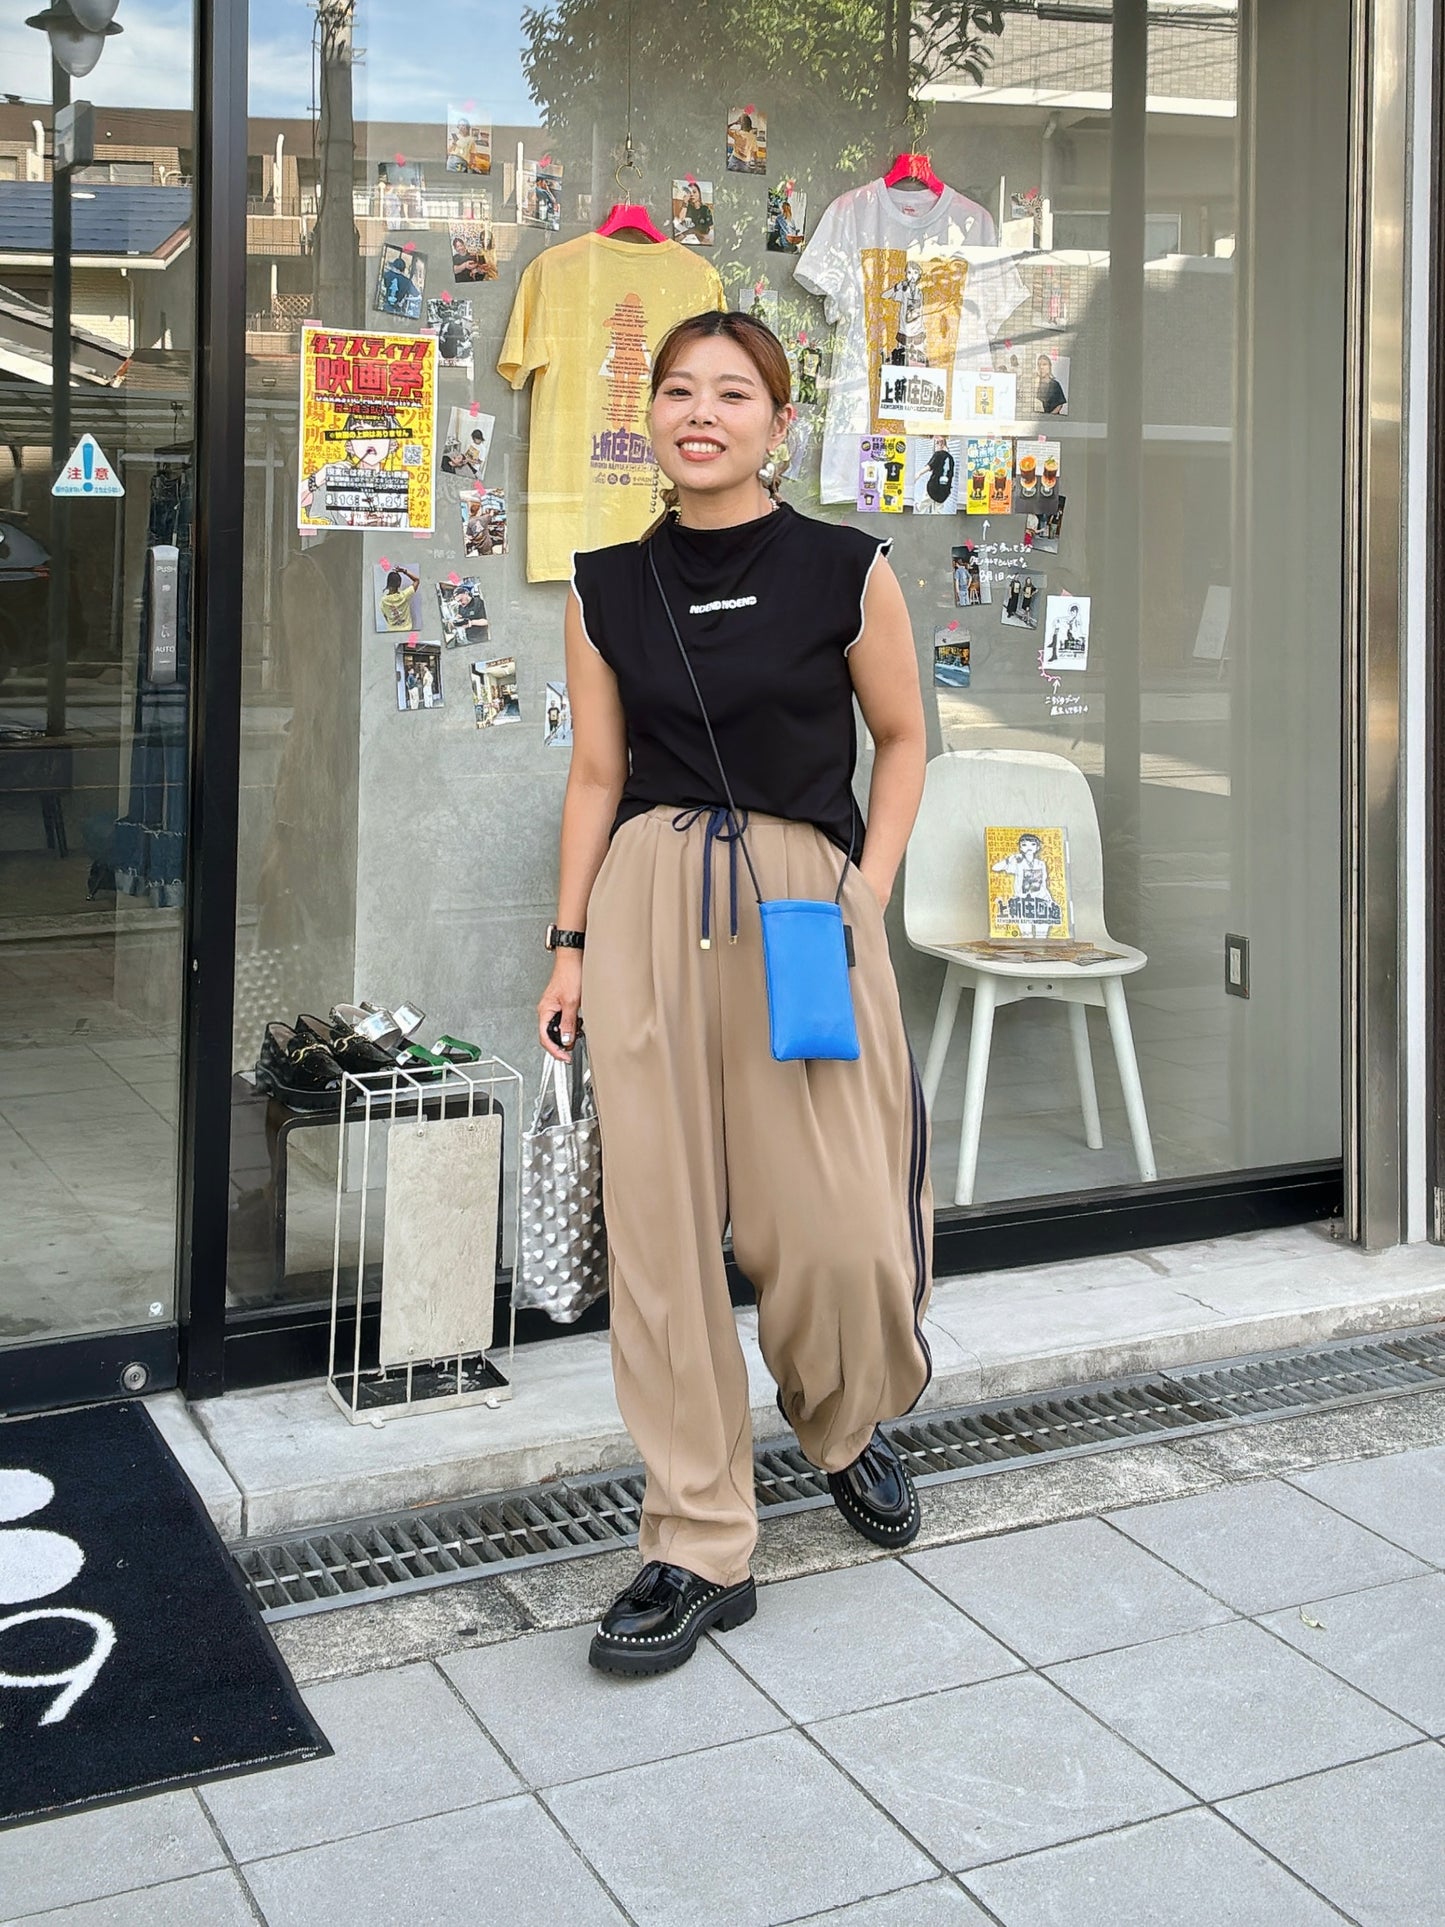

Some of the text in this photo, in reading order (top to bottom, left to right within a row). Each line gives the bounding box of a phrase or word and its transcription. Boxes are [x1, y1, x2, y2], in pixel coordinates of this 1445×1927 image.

[315, 357, 424, 398] 映画祭
[362, 395, 383, 406] FILM
[384, 397, 423, 408] FESTIVAL
[155, 645, 176, 653] AUTO
